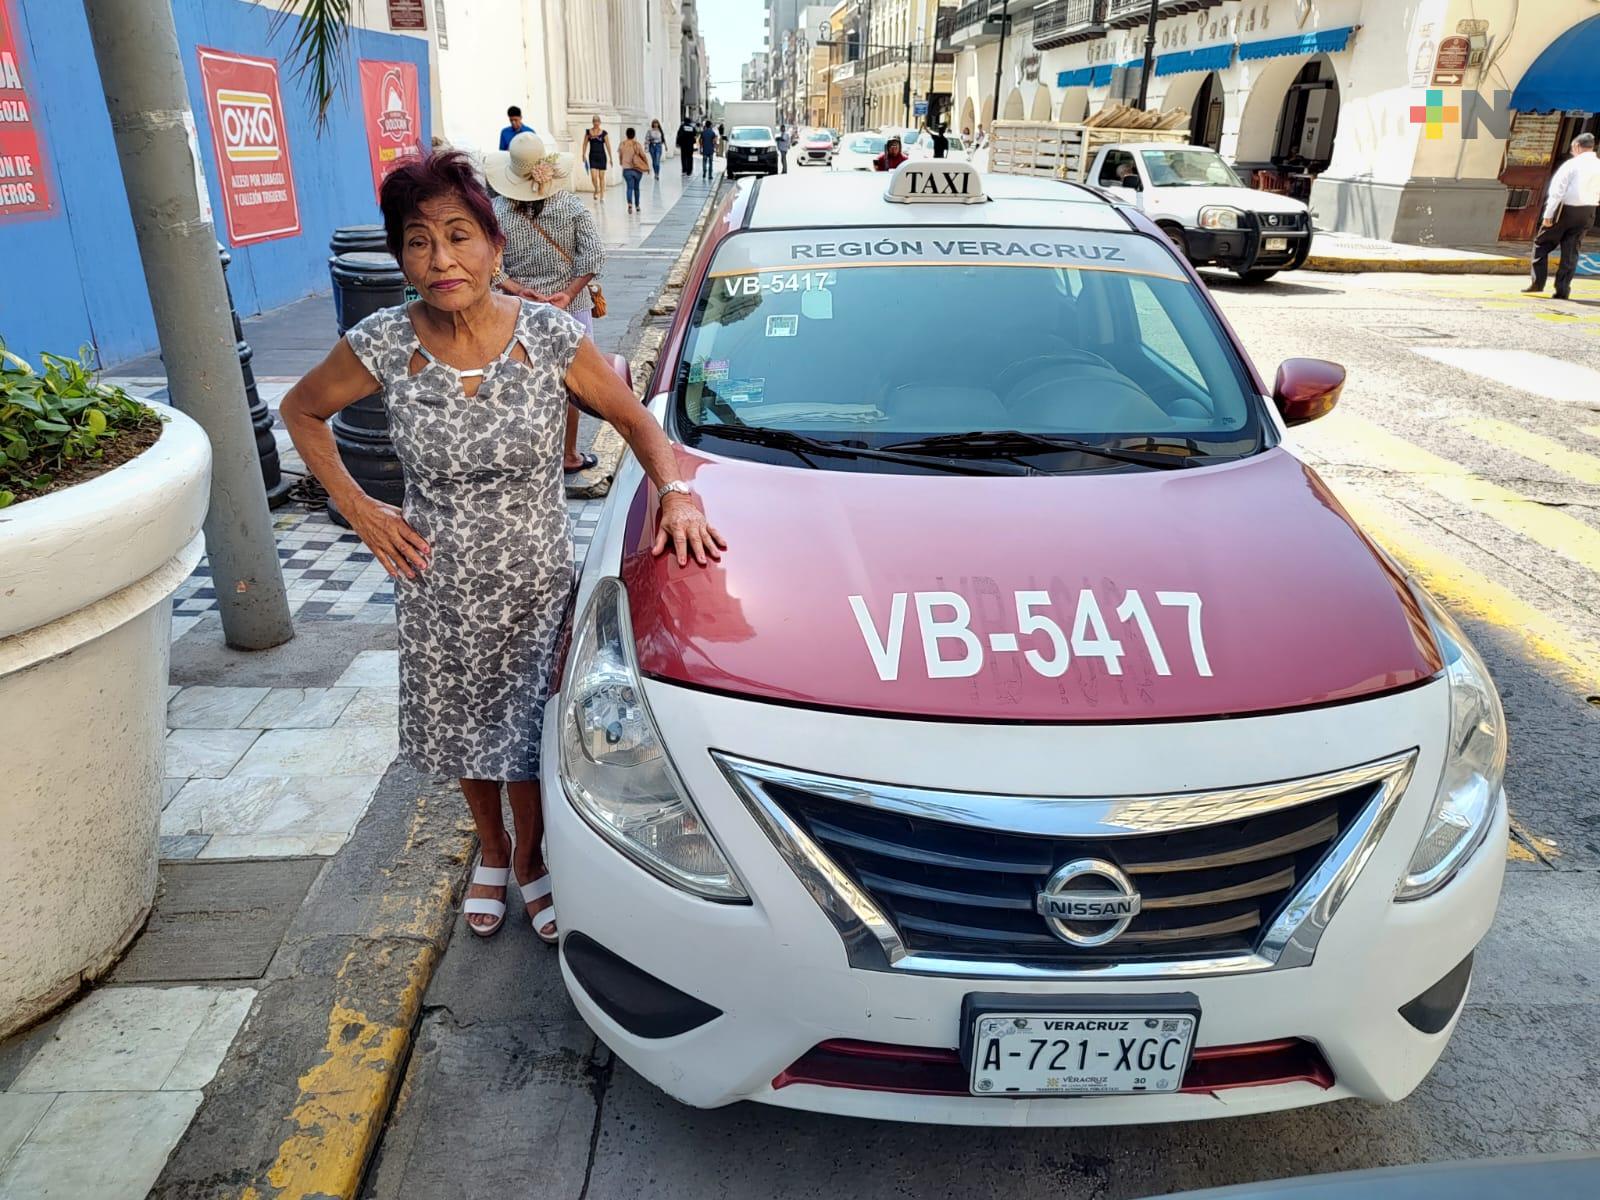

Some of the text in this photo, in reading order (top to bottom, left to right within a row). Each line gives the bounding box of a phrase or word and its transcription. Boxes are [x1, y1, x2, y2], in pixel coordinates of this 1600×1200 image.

[223, 106, 274, 147] OXXO
[14, 155, 34, 176] DE
[905, 171, 971, 194] TAXI
[791, 238, 1126, 262] REGIÓN VERACRUZ
[724, 271, 829, 297] VB-5417
[847, 588, 1214, 681] VB-5417
[1050, 901, 1133, 916] NISSAN
[1043, 1021, 1130, 1031] VERACRUZ
[983, 1038, 1181, 1071] A-721-XGC
